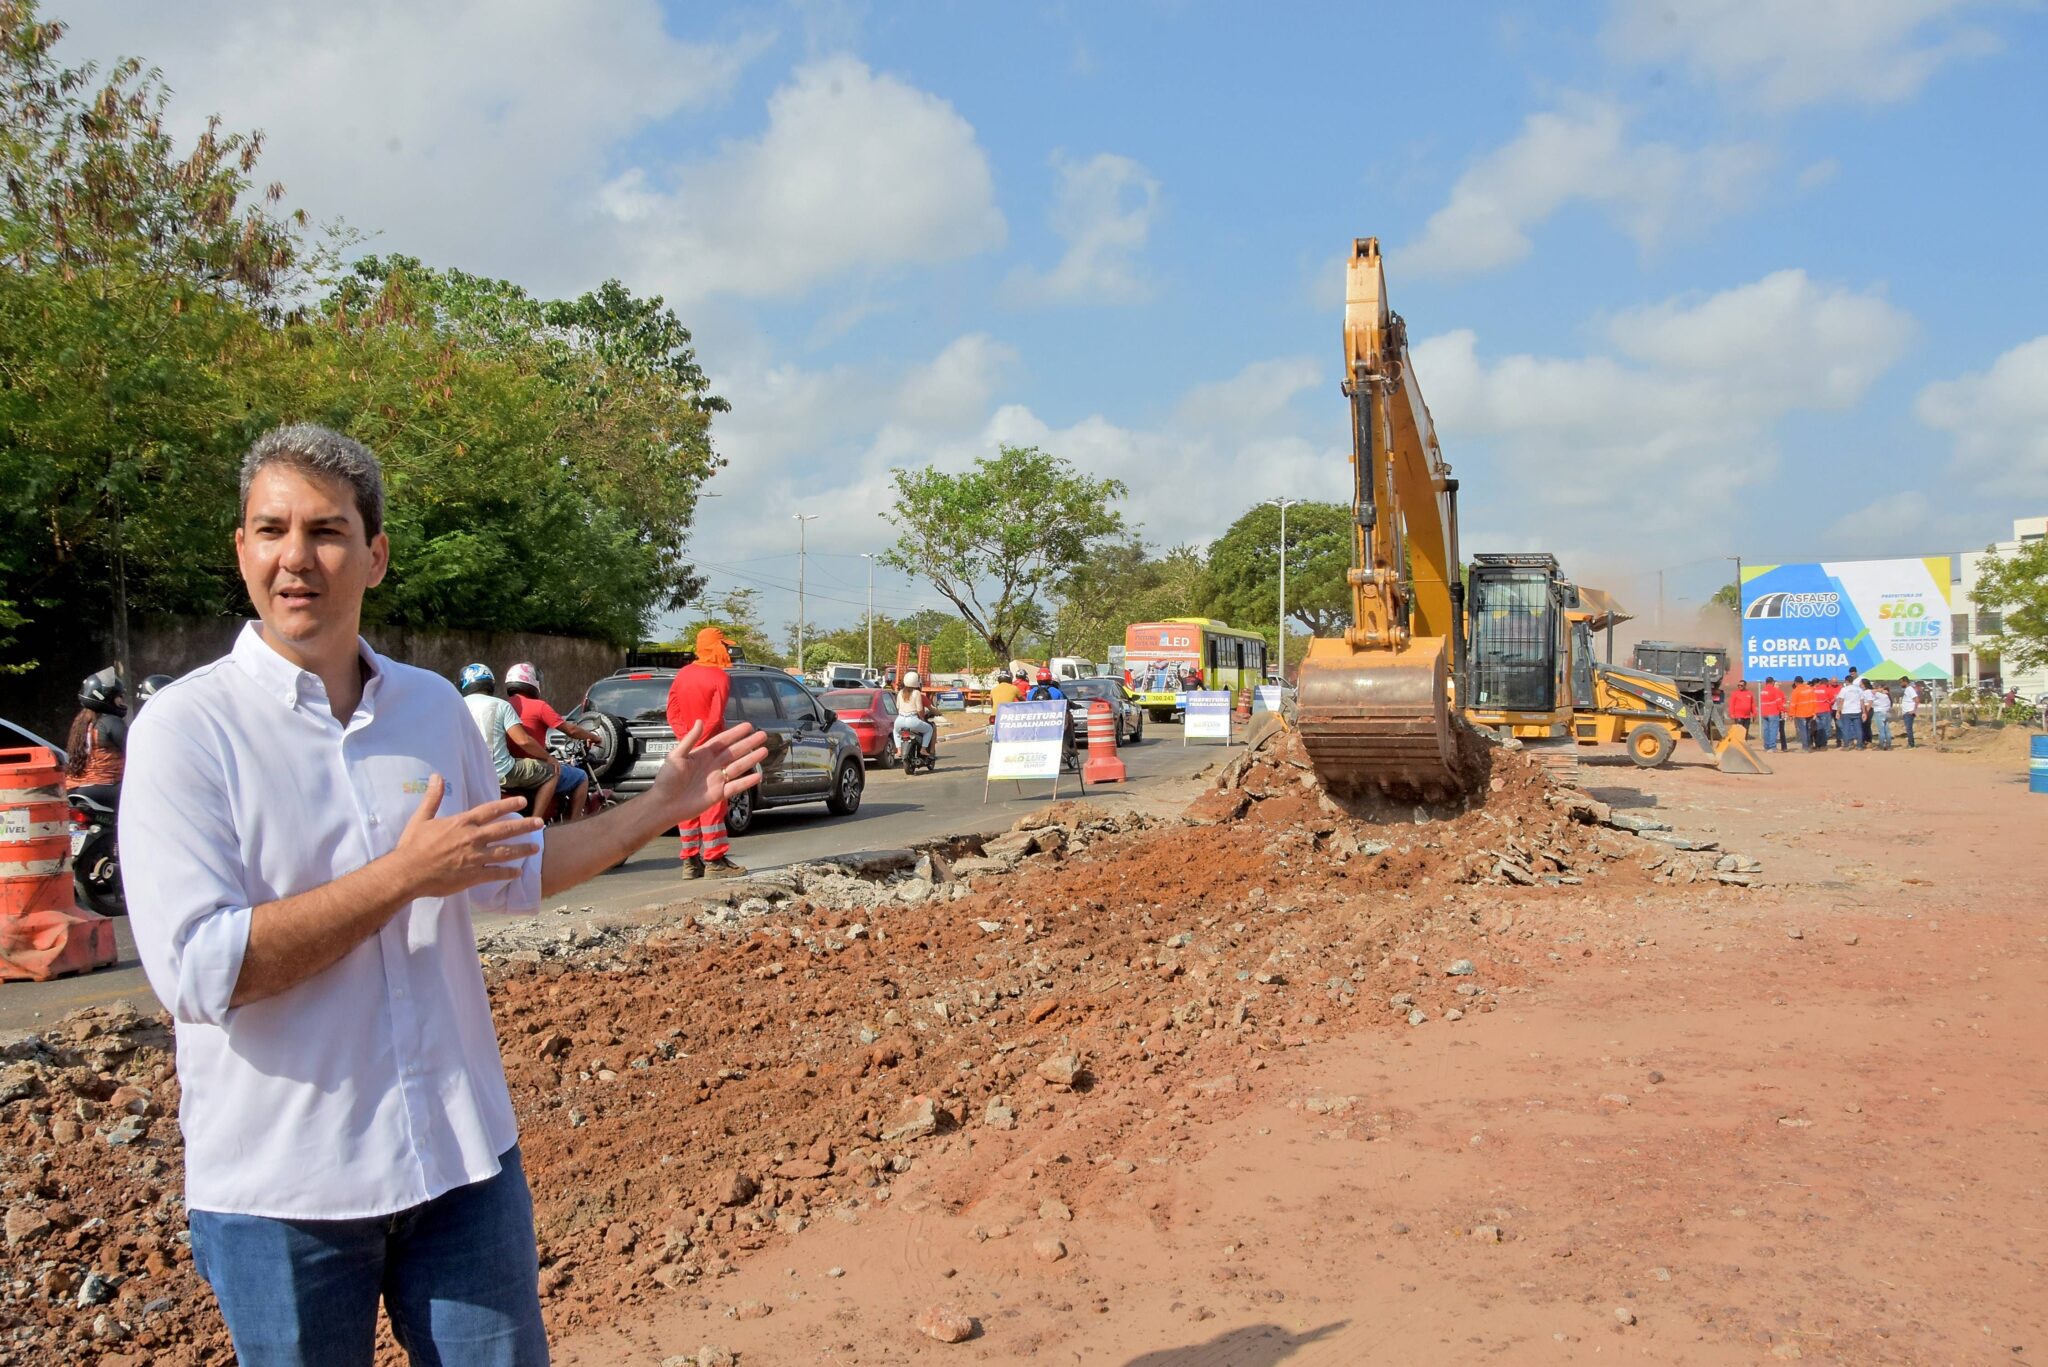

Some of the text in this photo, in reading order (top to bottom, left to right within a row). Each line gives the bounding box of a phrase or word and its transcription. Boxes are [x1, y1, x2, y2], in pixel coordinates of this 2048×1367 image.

[1787, 593, 1839, 603] ASFALTO
[1785, 603, 1840, 618] NOVO
[1878, 599, 1924, 619] SÃO
[1893, 616, 1942, 637] LUÍS
[1166, 637, 1190, 646] LED
[1748, 635, 1841, 653] É OBRA DA
[1890, 642, 1938, 652] SEMOSP
[1748, 653, 1849, 668] PREFEITURA
[1656, 696, 1675, 709] 310L
[1000, 712, 1063, 721] PREFEITURA
[1000, 720, 1063, 729] TRABALHANDO
